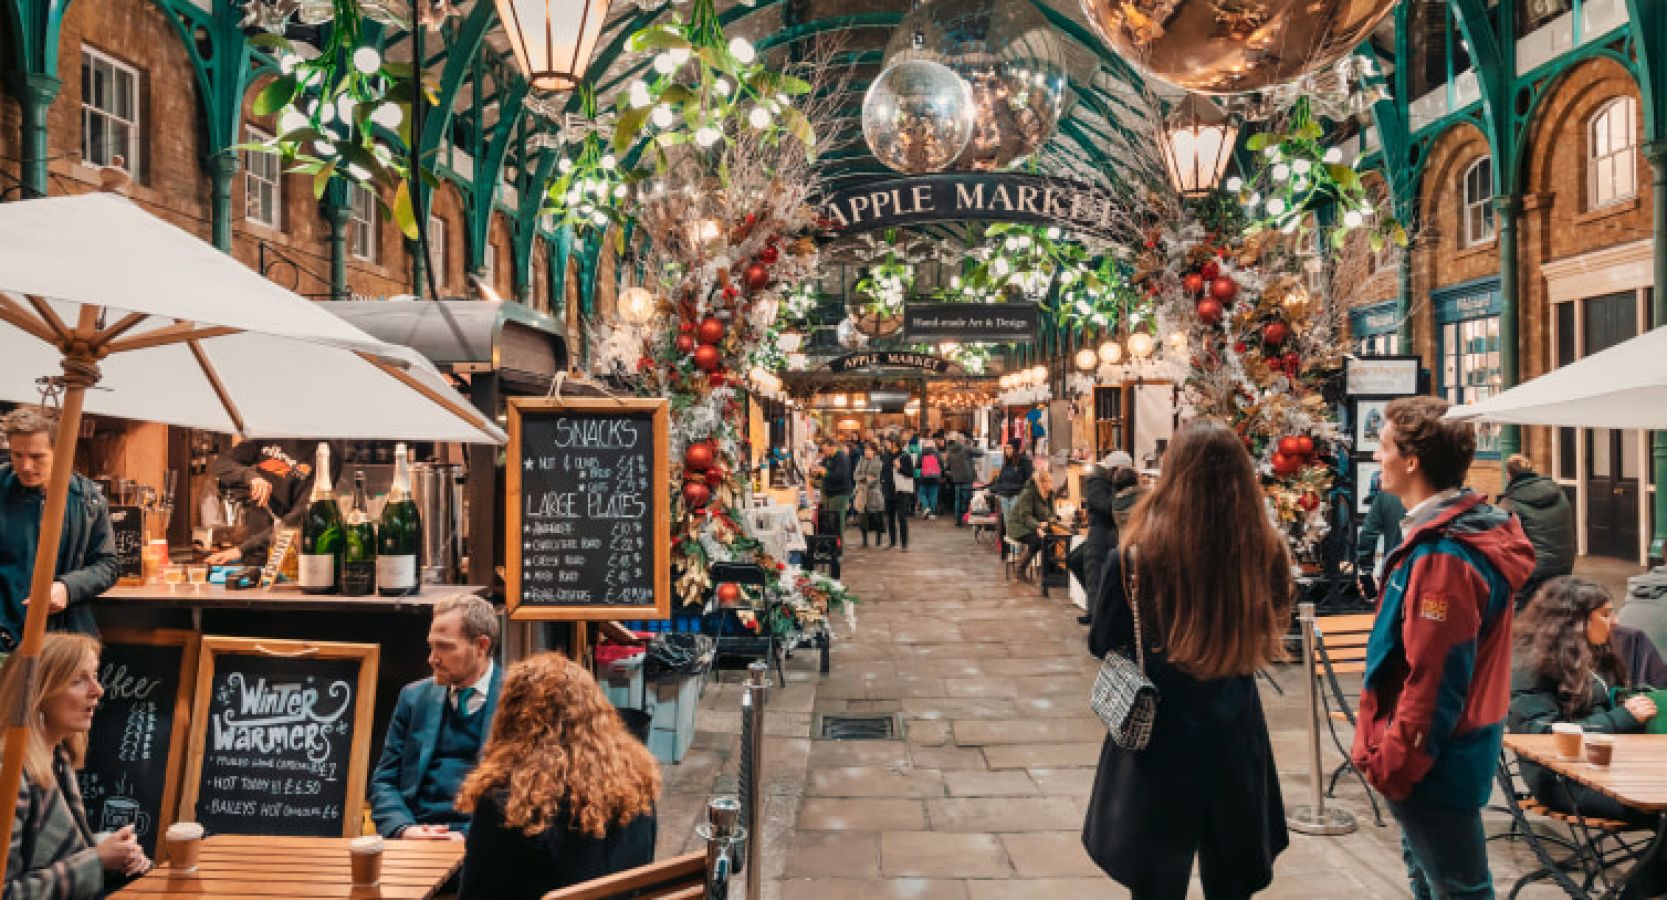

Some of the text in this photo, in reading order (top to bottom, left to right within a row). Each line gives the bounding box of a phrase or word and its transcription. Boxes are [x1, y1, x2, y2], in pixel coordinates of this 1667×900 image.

[826, 185, 935, 227] APPLE
[913, 317, 965, 328] Hand-made
[968, 318, 982, 328] Art
[996, 318, 1028, 330] Design
[844, 353, 938, 370] APPLE MARKET
[554, 417, 637, 448] SNACKS
[526, 491, 647, 518] LARGE PLATES
[213, 776, 239, 790] HOT
